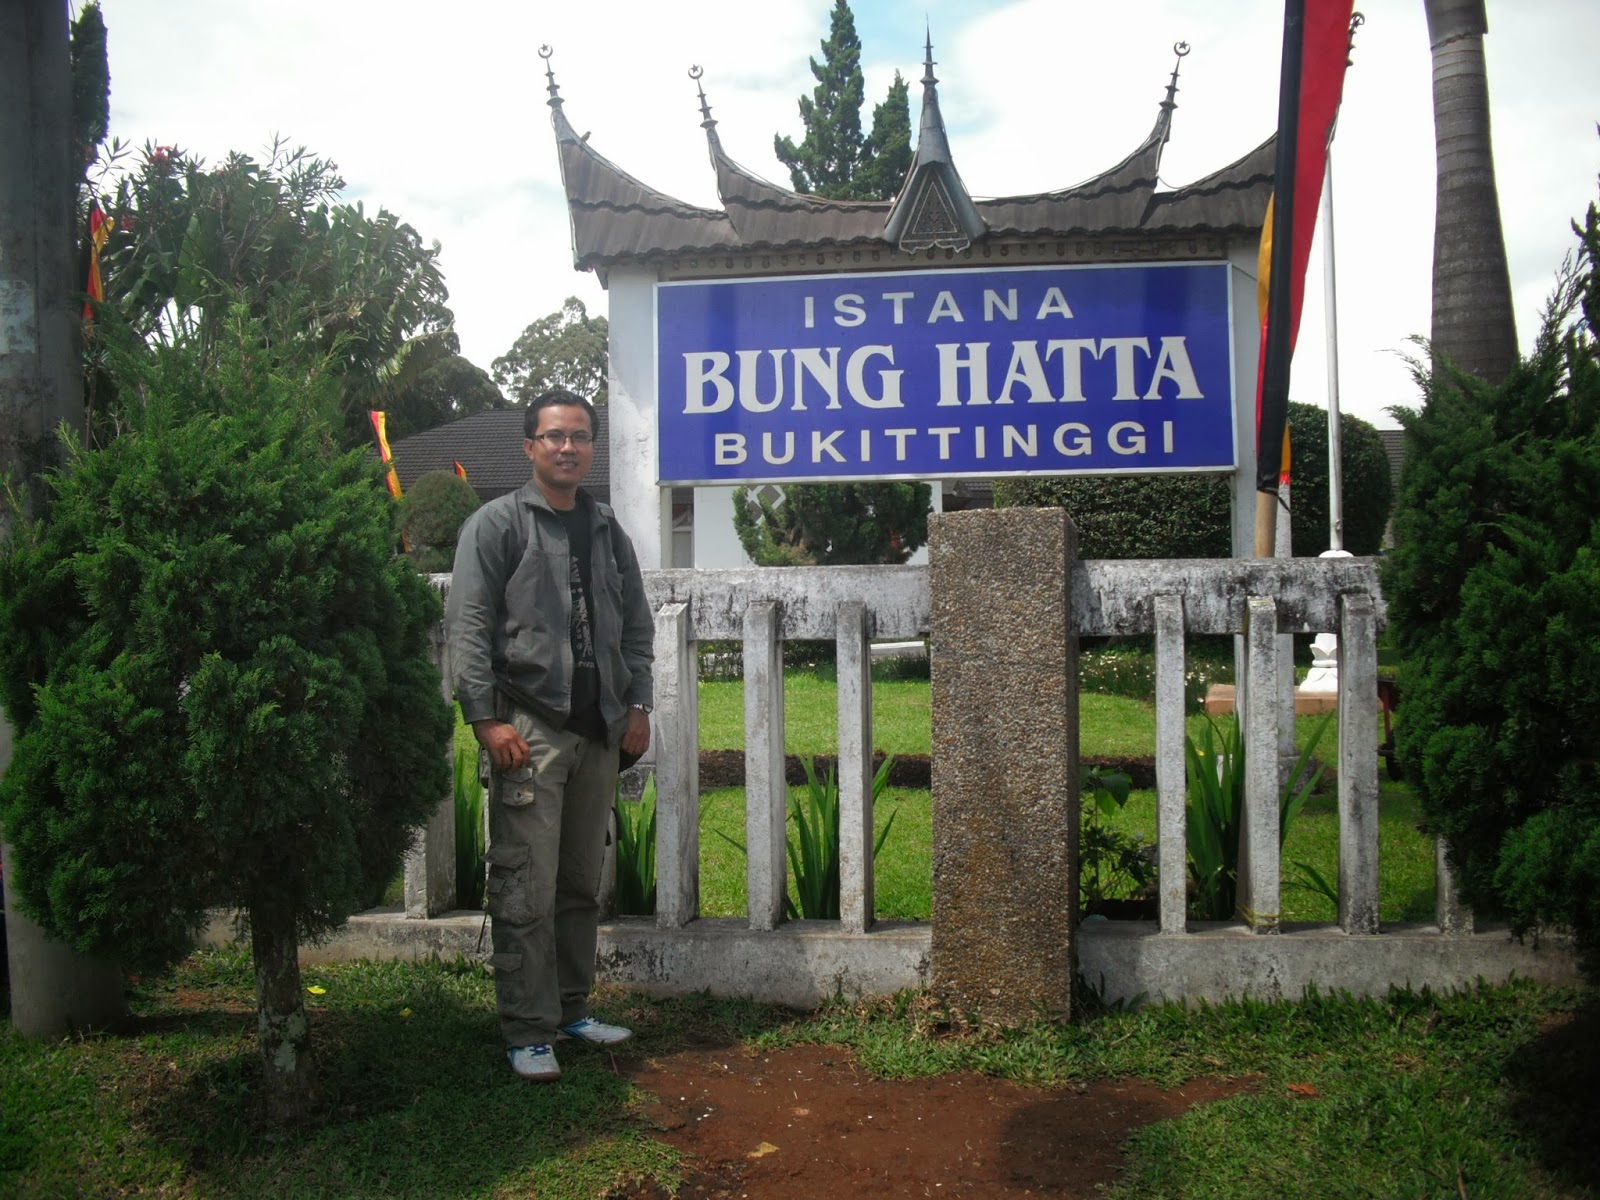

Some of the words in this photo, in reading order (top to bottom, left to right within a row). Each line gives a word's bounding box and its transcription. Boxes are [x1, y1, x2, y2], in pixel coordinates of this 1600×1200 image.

[804, 286, 1074, 328] ISTANA
[681, 344, 905, 414] BUNG
[935, 336, 1205, 406] HATTA
[714, 420, 1173, 465] BUKITTINGGI
